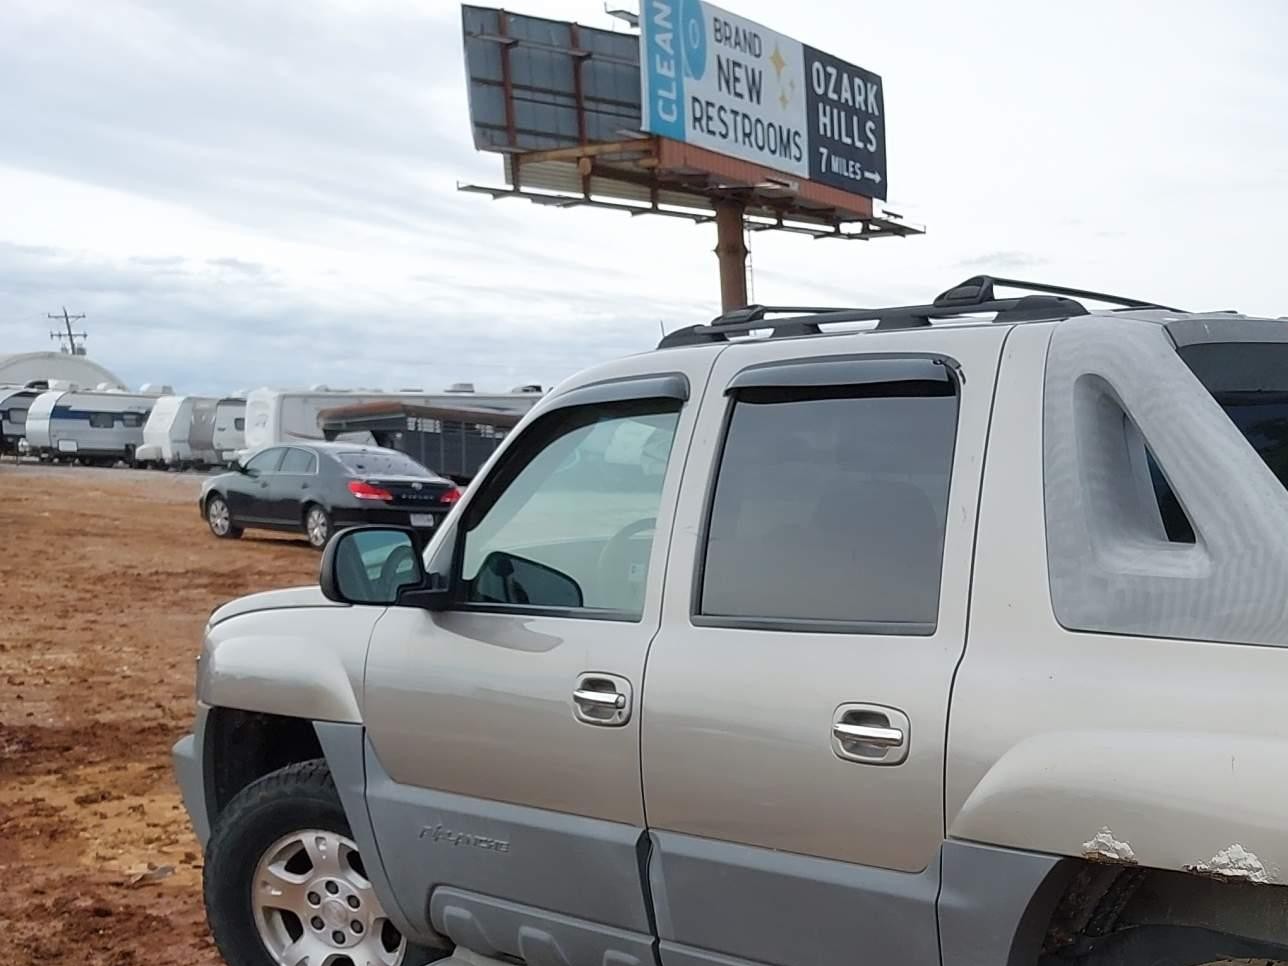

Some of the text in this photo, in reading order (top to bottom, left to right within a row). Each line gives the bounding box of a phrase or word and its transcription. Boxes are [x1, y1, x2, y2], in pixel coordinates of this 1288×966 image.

[653, 0, 678, 123] CLEAN
[713, 17, 762, 59] BRAND
[717, 54, 763, 105] NEW
[812, 61, 879, 116] OZARK
[691, 96, 803, 163] RESTROOMS
[818, 102, 877, 153] HILLS
[819, 147, 861, 180] 7 MILES
